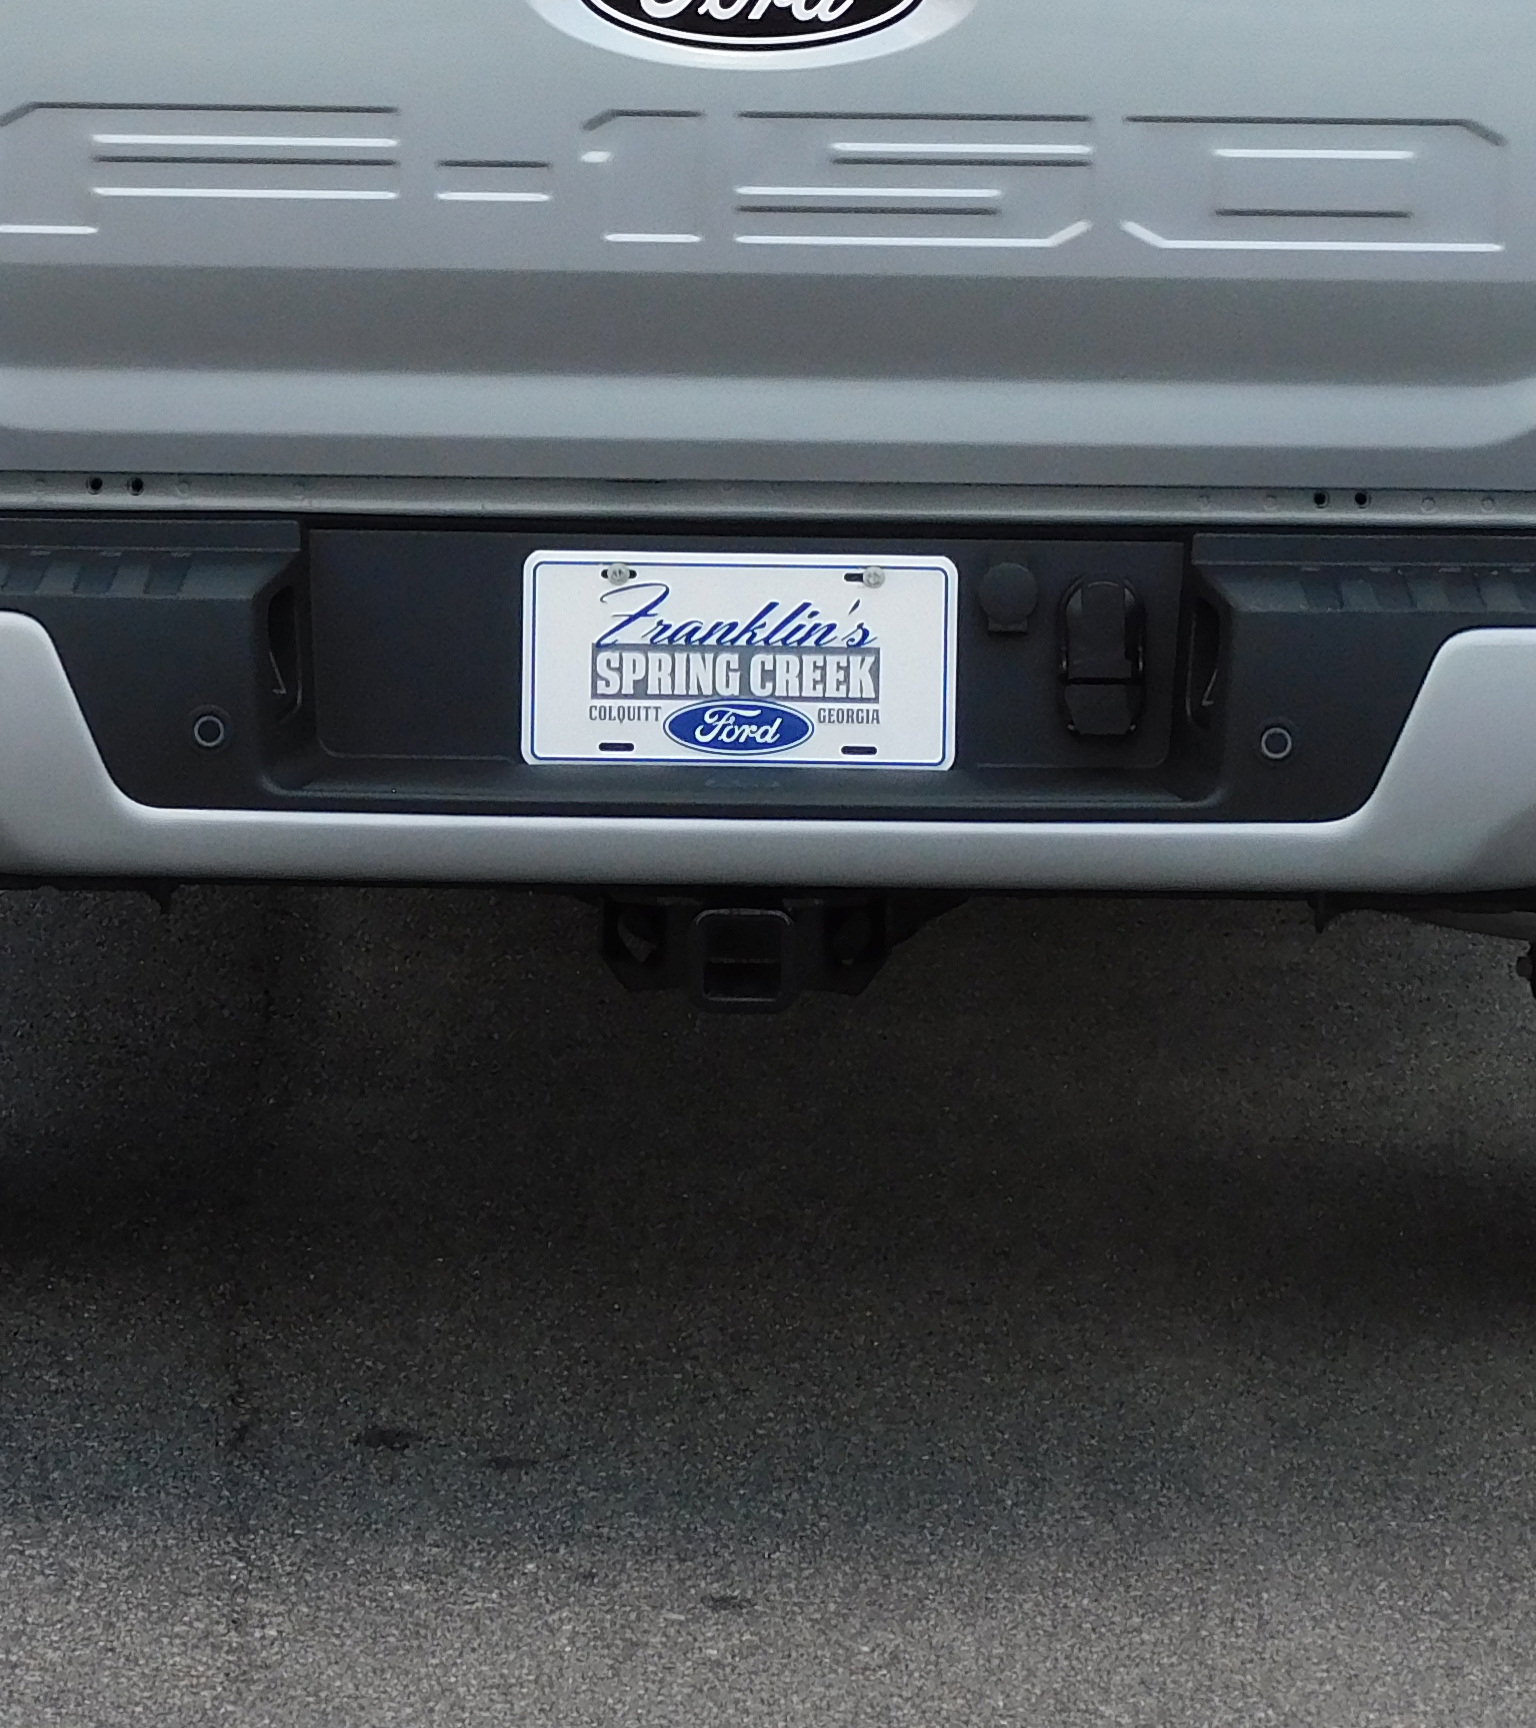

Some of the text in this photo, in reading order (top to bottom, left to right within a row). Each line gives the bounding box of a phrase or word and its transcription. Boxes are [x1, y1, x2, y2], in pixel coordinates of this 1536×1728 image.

[596, 582, 878, 647] Franklin's
[596, 651, 876, 699] SPRING CREEK
[588, 705, 662, 724] COLQUITT
[694, 707, 782, 745] Ford
[817, 707, 881, 725] GEORGIA
